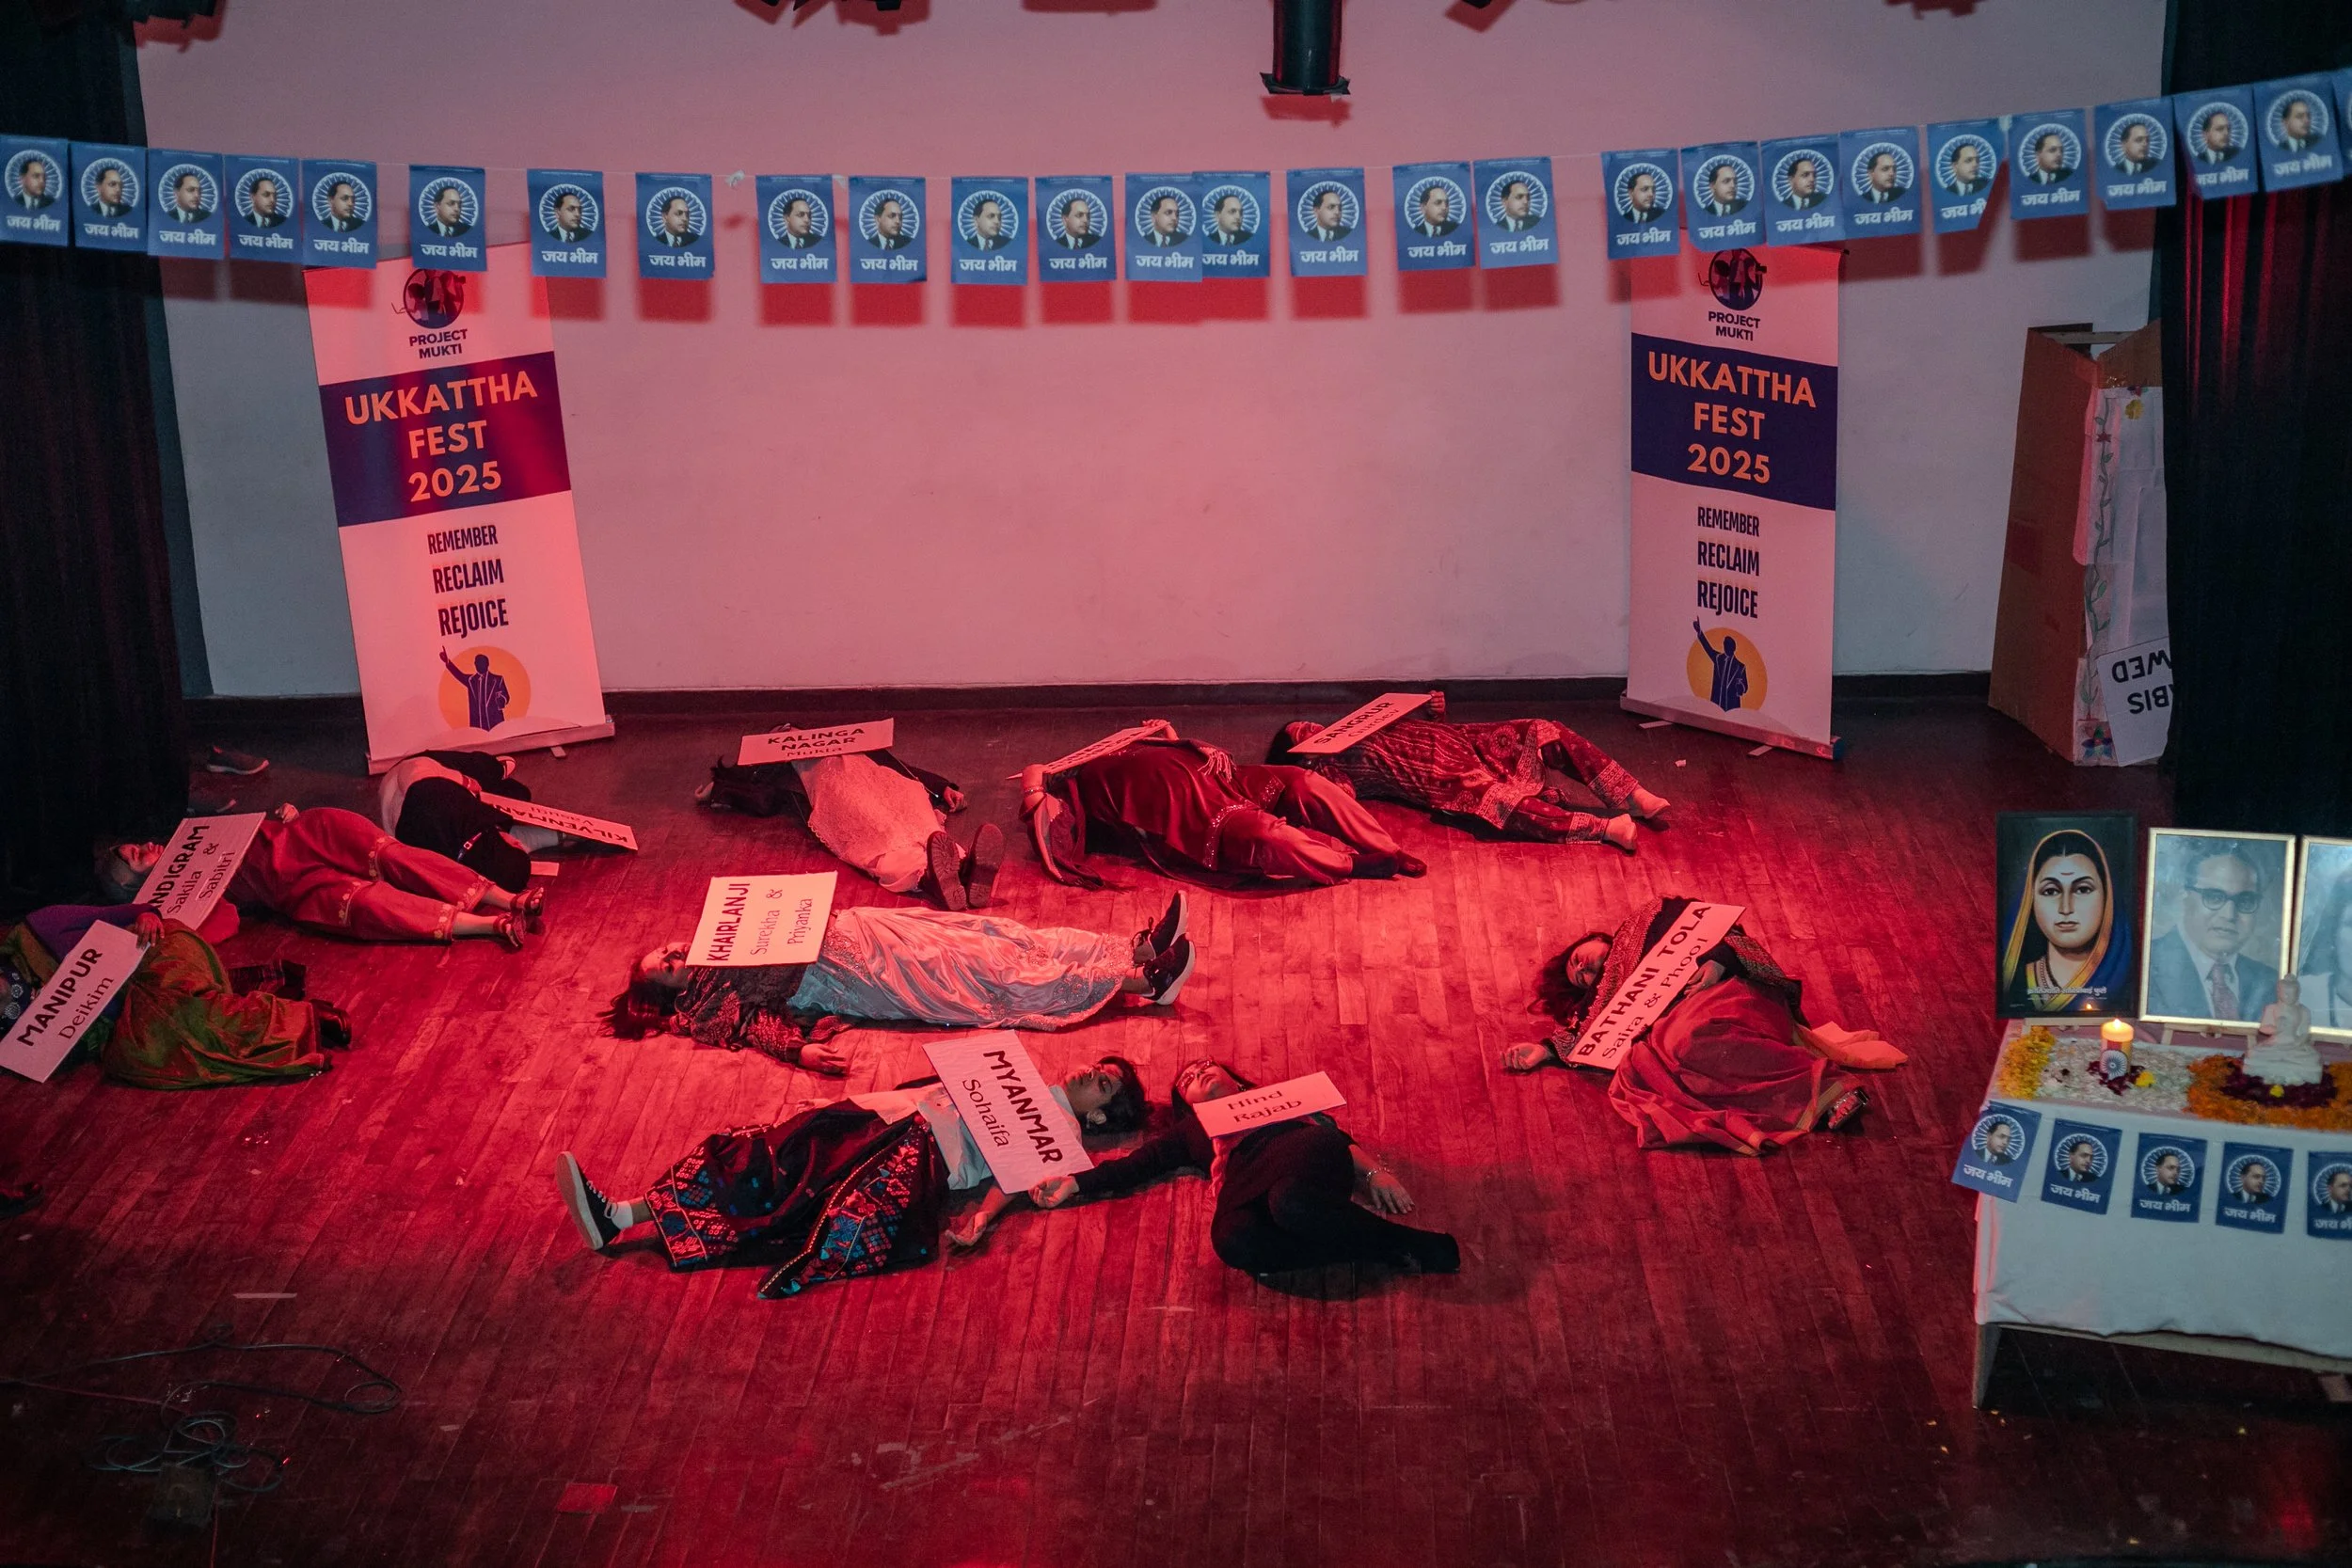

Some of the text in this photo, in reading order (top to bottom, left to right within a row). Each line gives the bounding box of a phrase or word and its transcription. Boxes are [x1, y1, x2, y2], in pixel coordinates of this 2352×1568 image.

[2219, 166, 2249, 182] भीम
[2274, 153, 2332, 176] जय भीम
[2022, 187, 2080, 205] जय भीम
[2107, 178, 2167, 197] जय भीम
[1854, 207, 1913, 224] जय भीम
[1942, 198, 1987, 218] जय भी
[8, 214, 60, 231] जय भीम
[85, 223, 138, 239] जय भीम
[1698, 219, 1756, 238] जय भीम
[1776, 213, 1835, 231] जय भीम
[159, 229, 215, 245] जय भीम
[239, 233, 293, 249] जय भीम
[313, 237, 369, 254] जय भीम
[1490, 235, 1549, 253] जय भीम
[1617, 227, 1671, 245] जय भीम
[421, 242, 477, 258] जय भीम
[542, 247, 598, 263] जय भीम
[1202, 249, 1259, 265] जय भीम
[1300, 246, 1359, 262] जय भीम
[1407, 241, 1466, 257] जय भीम
[649, 252, 706, 267] जय भीम
[771, 254, 828, 269] जय भीम
[861, 255, 918, 271] जय भीम
[960, 256, 1017, 271] जय भीम
[1050, 253, 1107, 269] जय भीम
[1136, 252, 1194, 268] जय भीम
[1708, 311, 1760, 328] PROJECT
[409, 329, 468, 346] PROJECT
[1716, 325, 1754, 341] MUKTI
[419, 344, 462, 358] MUKTI
[1648, 351, 1817, 408] UKKATTHA
[344, 371, 538, 425] UKKATTHA
[1694, 402, 1765, 440] FEST
[408, 420, 487, 459] FEST
[1687, 443, 1771, 484] 2025
[408, 460, 501, 502] 2025
[1697, 506, 1759, 537] REMEMBER
[427, 525, 498, 555] REMEMBER
[1697, 541, 1759, 577] RECLAIM
[433, 559, 504, 594] RECLAIM
[1697, 580, 1758, 619] REJOICE
[437, 598, 509, 639] REJOICE
[2127, 684, 2173, 714] BIS
[1313, 701, 1394, 744] SANGRUR
[768, 728, 865, 744] KALINGA
[781, 737, 856, 751] NAGAR
[495, 804, 628, 843] KILVENMAN
[148, 825, 210, 908] NDIGRAM
[199, 852, 235, 899] Sabitri
[167, 843, 219, 913] Sakila &
[707, 883, 751, 961] KHAIRLANJI
[750, 889, 783, 956] Surekha &
[787, 898, 813, 944] Priyanka
[1578, 906, 1711, 1056] BATHANI TOLA
[17, 948, 103, 1047] MANIPUR
[58, 977, 114, 1039] Deikim
[1602, 1017, 1644, 1059] Saira
[1645, 993, 1663, 1008] &
[983, 1050, 1063, 1164] MYANMAR
[1228, 1090, 1282, 1110] Hind
[962, 1079, 1010, 1148] Sohaifa
[1233, 1100, 1302, 1122] Rajab
[1963, 1164, 2013, 1187] जय भीम
[2051, 1184, 2101, 1203] जय भीम
[2139, 1199, 2190, 1212] जय भीम
[2225, 1208, 2276, 1222] जय भीम
